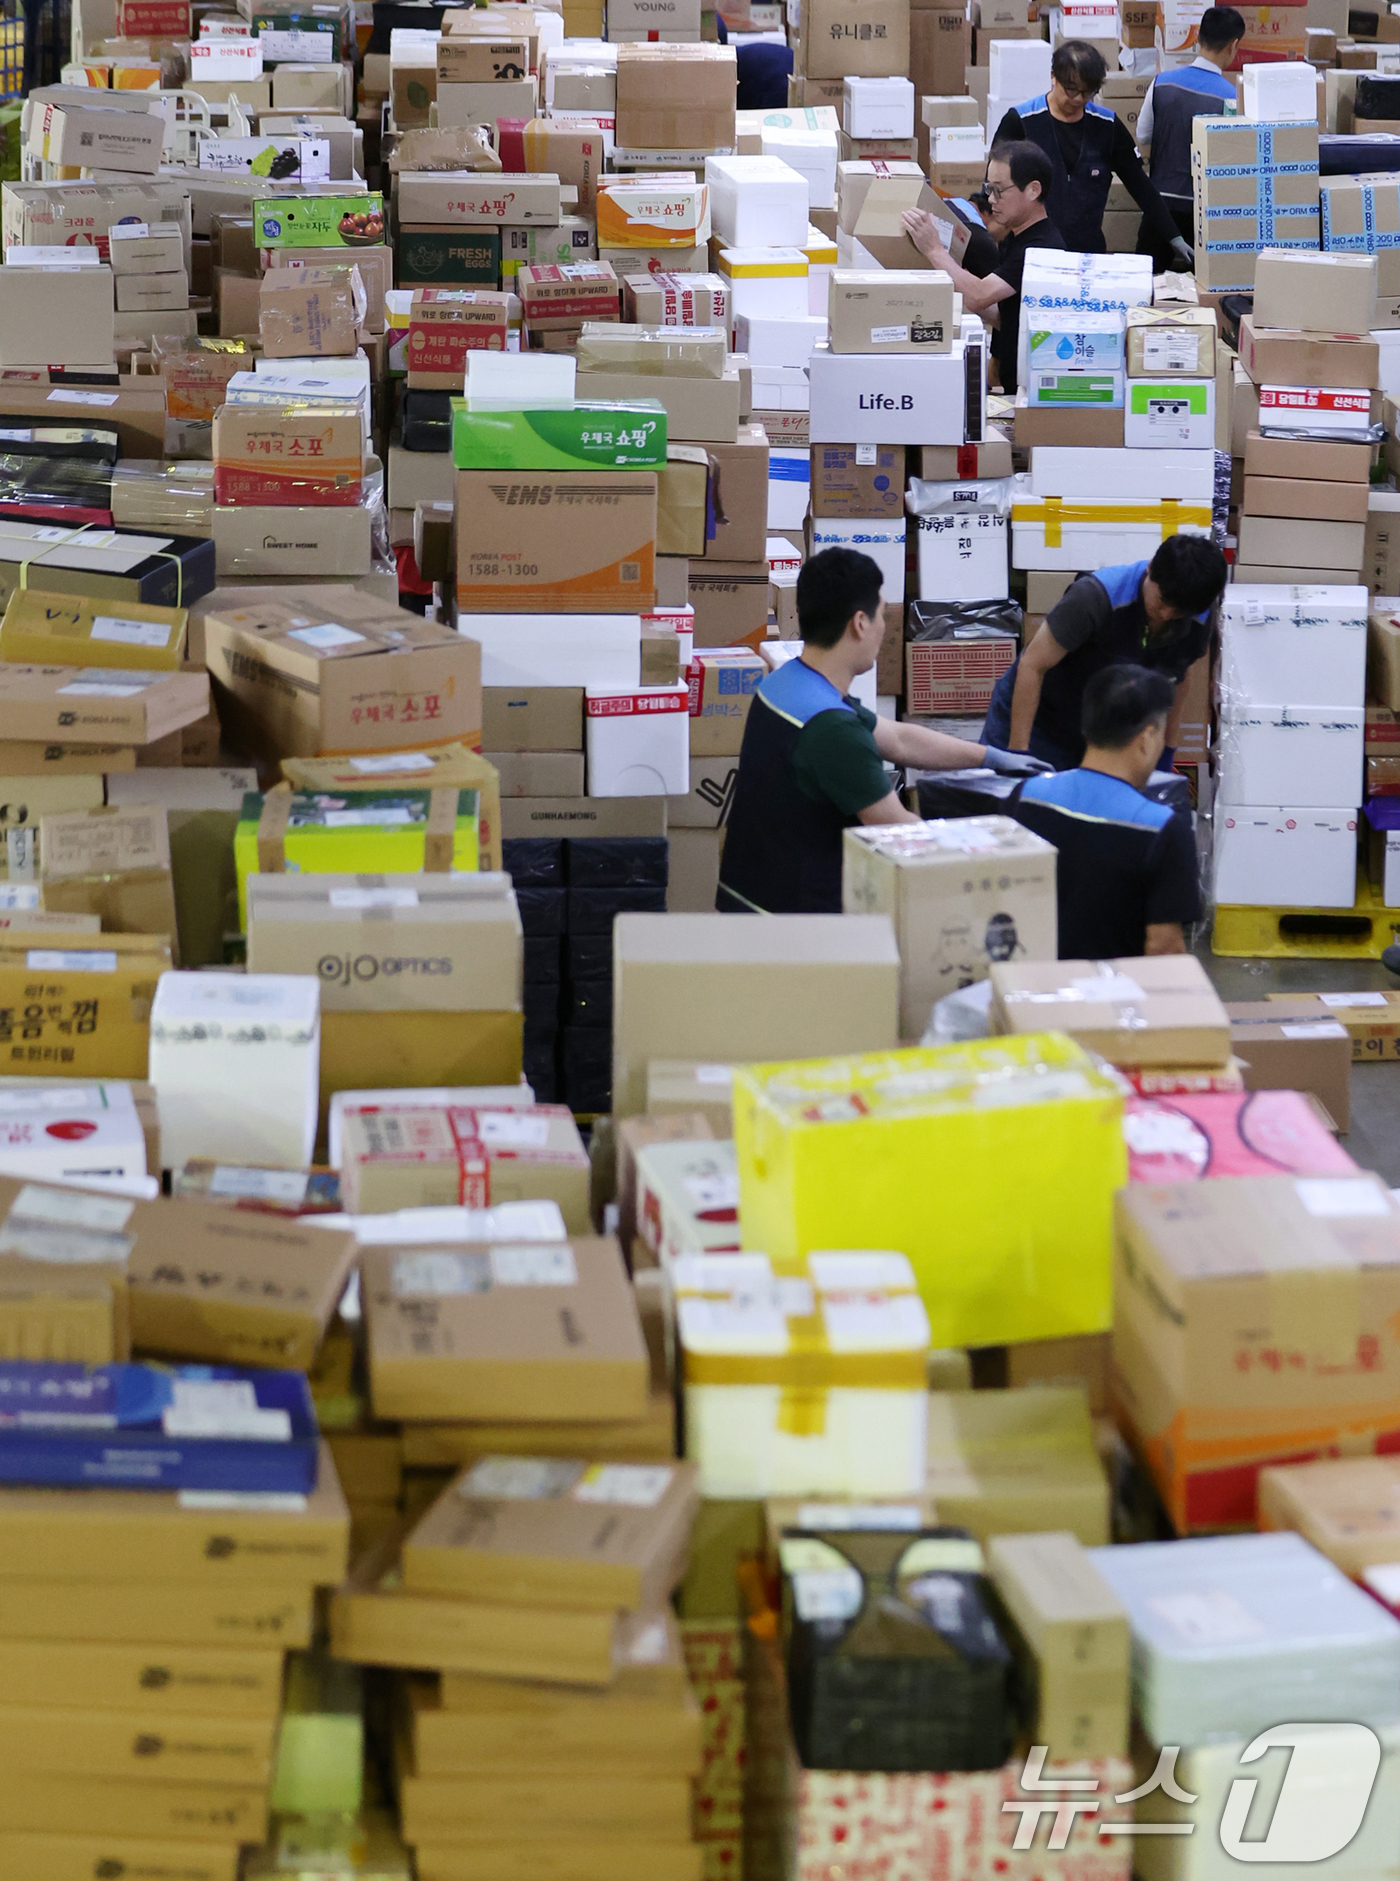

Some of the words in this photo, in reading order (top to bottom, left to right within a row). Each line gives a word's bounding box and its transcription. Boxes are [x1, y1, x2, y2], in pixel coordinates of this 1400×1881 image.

[633, 2, 676, 12] YOUNG
[1125, 11, 1148, 23] SSF
[829, 23, 888, 41] 유니클로
[1212, 168, 1236, 177] GOOD
[446, 202, 475, 212] 우체국
[478, 200, 507, 217] 쇼핑
[637, 205, 660, 215] 우체국
[662, 203, 685, 217] 쇼핑
[64, 217, 95, 228] 크라운
[448, 247, 492, 258] FRESH
[465, 257, 492, 269] EGGS
[578, 286, 609, 296] UPWARD
[465, 312, 496, 321] UPWARD
[428, 335, 447, 347] 계란
[449, 336, 486, 348] 파손주의
[1074, 333, 1087, 346] 참
[1074, 345, 1096, 358] 이슬
[413, 353, 452, 365] 신선식품
[859, 393, 914, 411] Life.B
[580, 431, 613, 444] 우체국
[615, 429, 647, 449] 쇼핑
[246, 440, 284, 454] 우체국
[287, 438, 325, 456] 소포
[506, 485, 553, 505] EMS
[468, 564, 539, 576] 1588-1300
[401, 694, 442, 723] 소포
[380, 956, 453, 976] OPTICS
